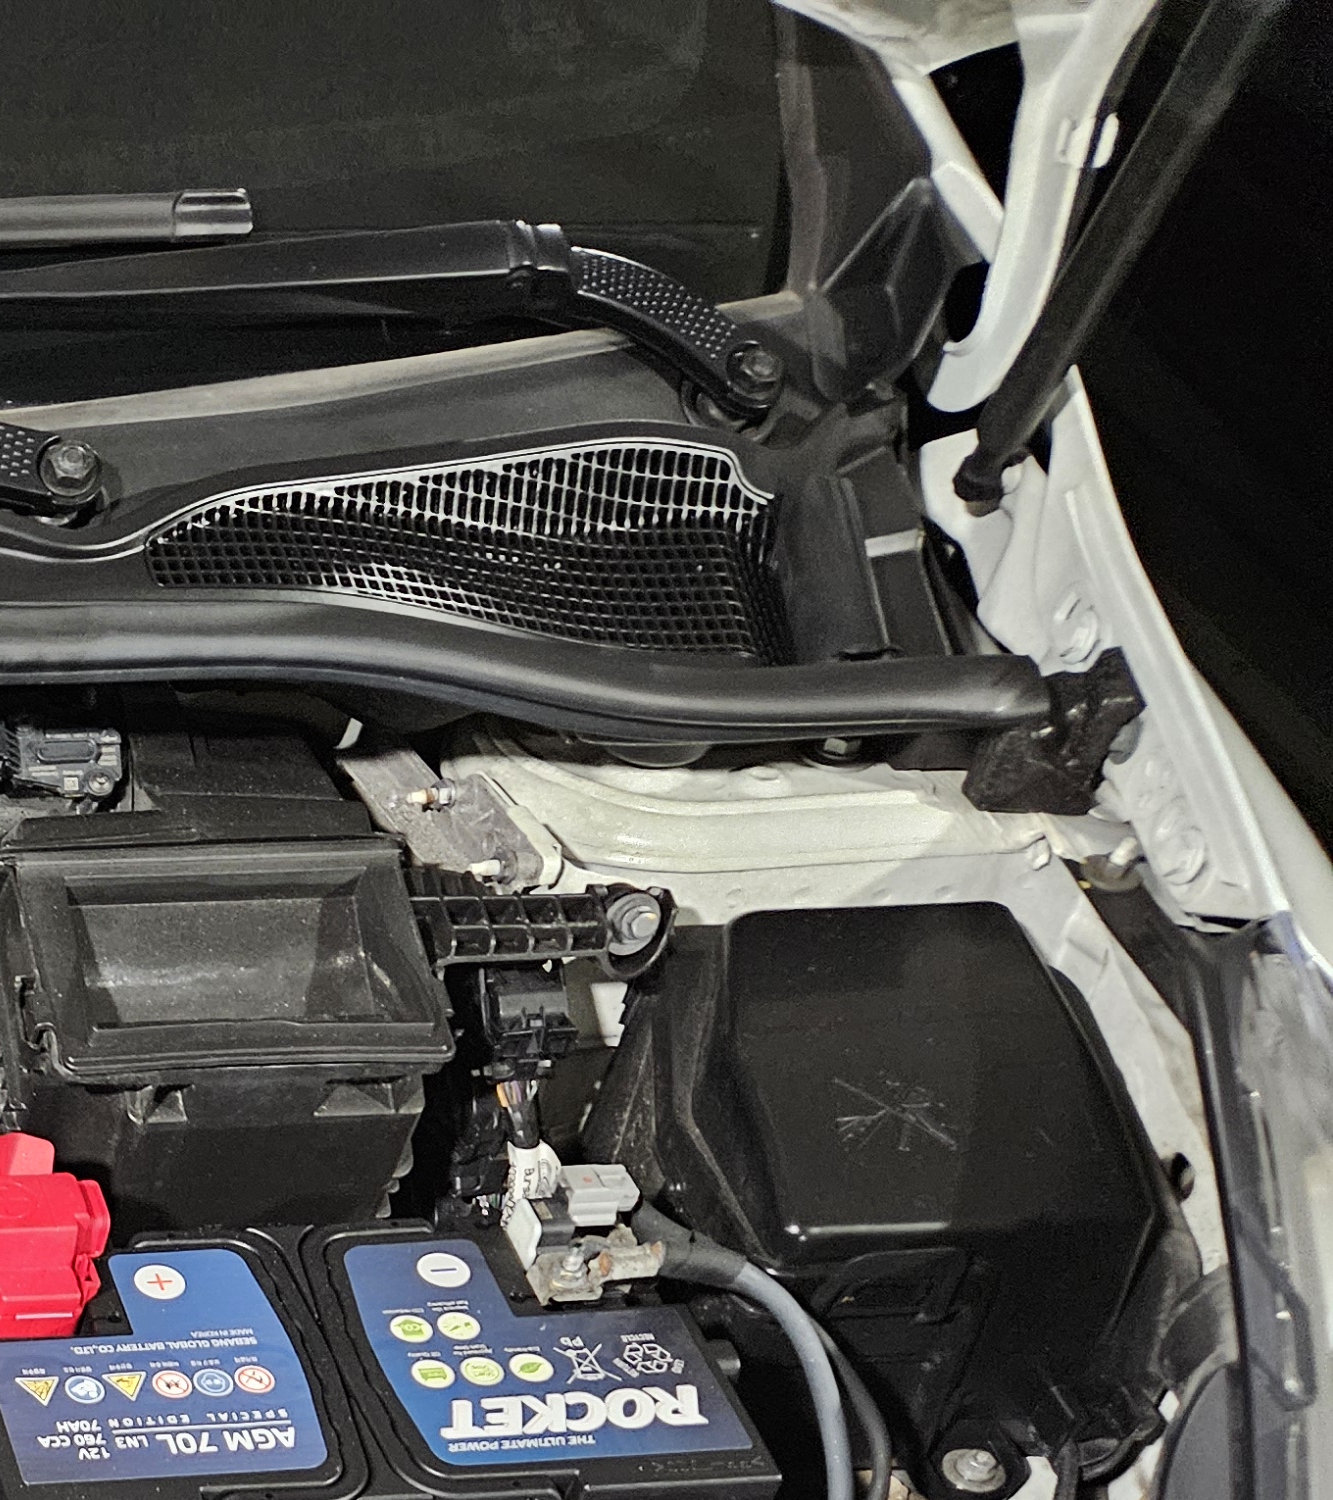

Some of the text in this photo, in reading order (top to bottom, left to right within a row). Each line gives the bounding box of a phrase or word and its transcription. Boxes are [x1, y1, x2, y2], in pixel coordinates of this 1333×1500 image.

[115, 1341, 165, 1352] BATTERY
[166, 1339, 210, 1350] GLOBAL
[211, 1337, 258, 1348] SEBANG
[560, 1336, 583, 1348] Pb
[108, 1408, 288, 1429] SPECIAL EDITION
[440, 1384, 710, 1439] ROCKET
[55, 1419, 102, 1433] 70AH
[36, 1433, 107, 1449] 760 CCA
[116, 1426, 296, 1455] AGM 70L LN3
[448, 1434, 595, 1453] THE ULTIMATE POWER
[78, 1446, 111, 1461] 12V
